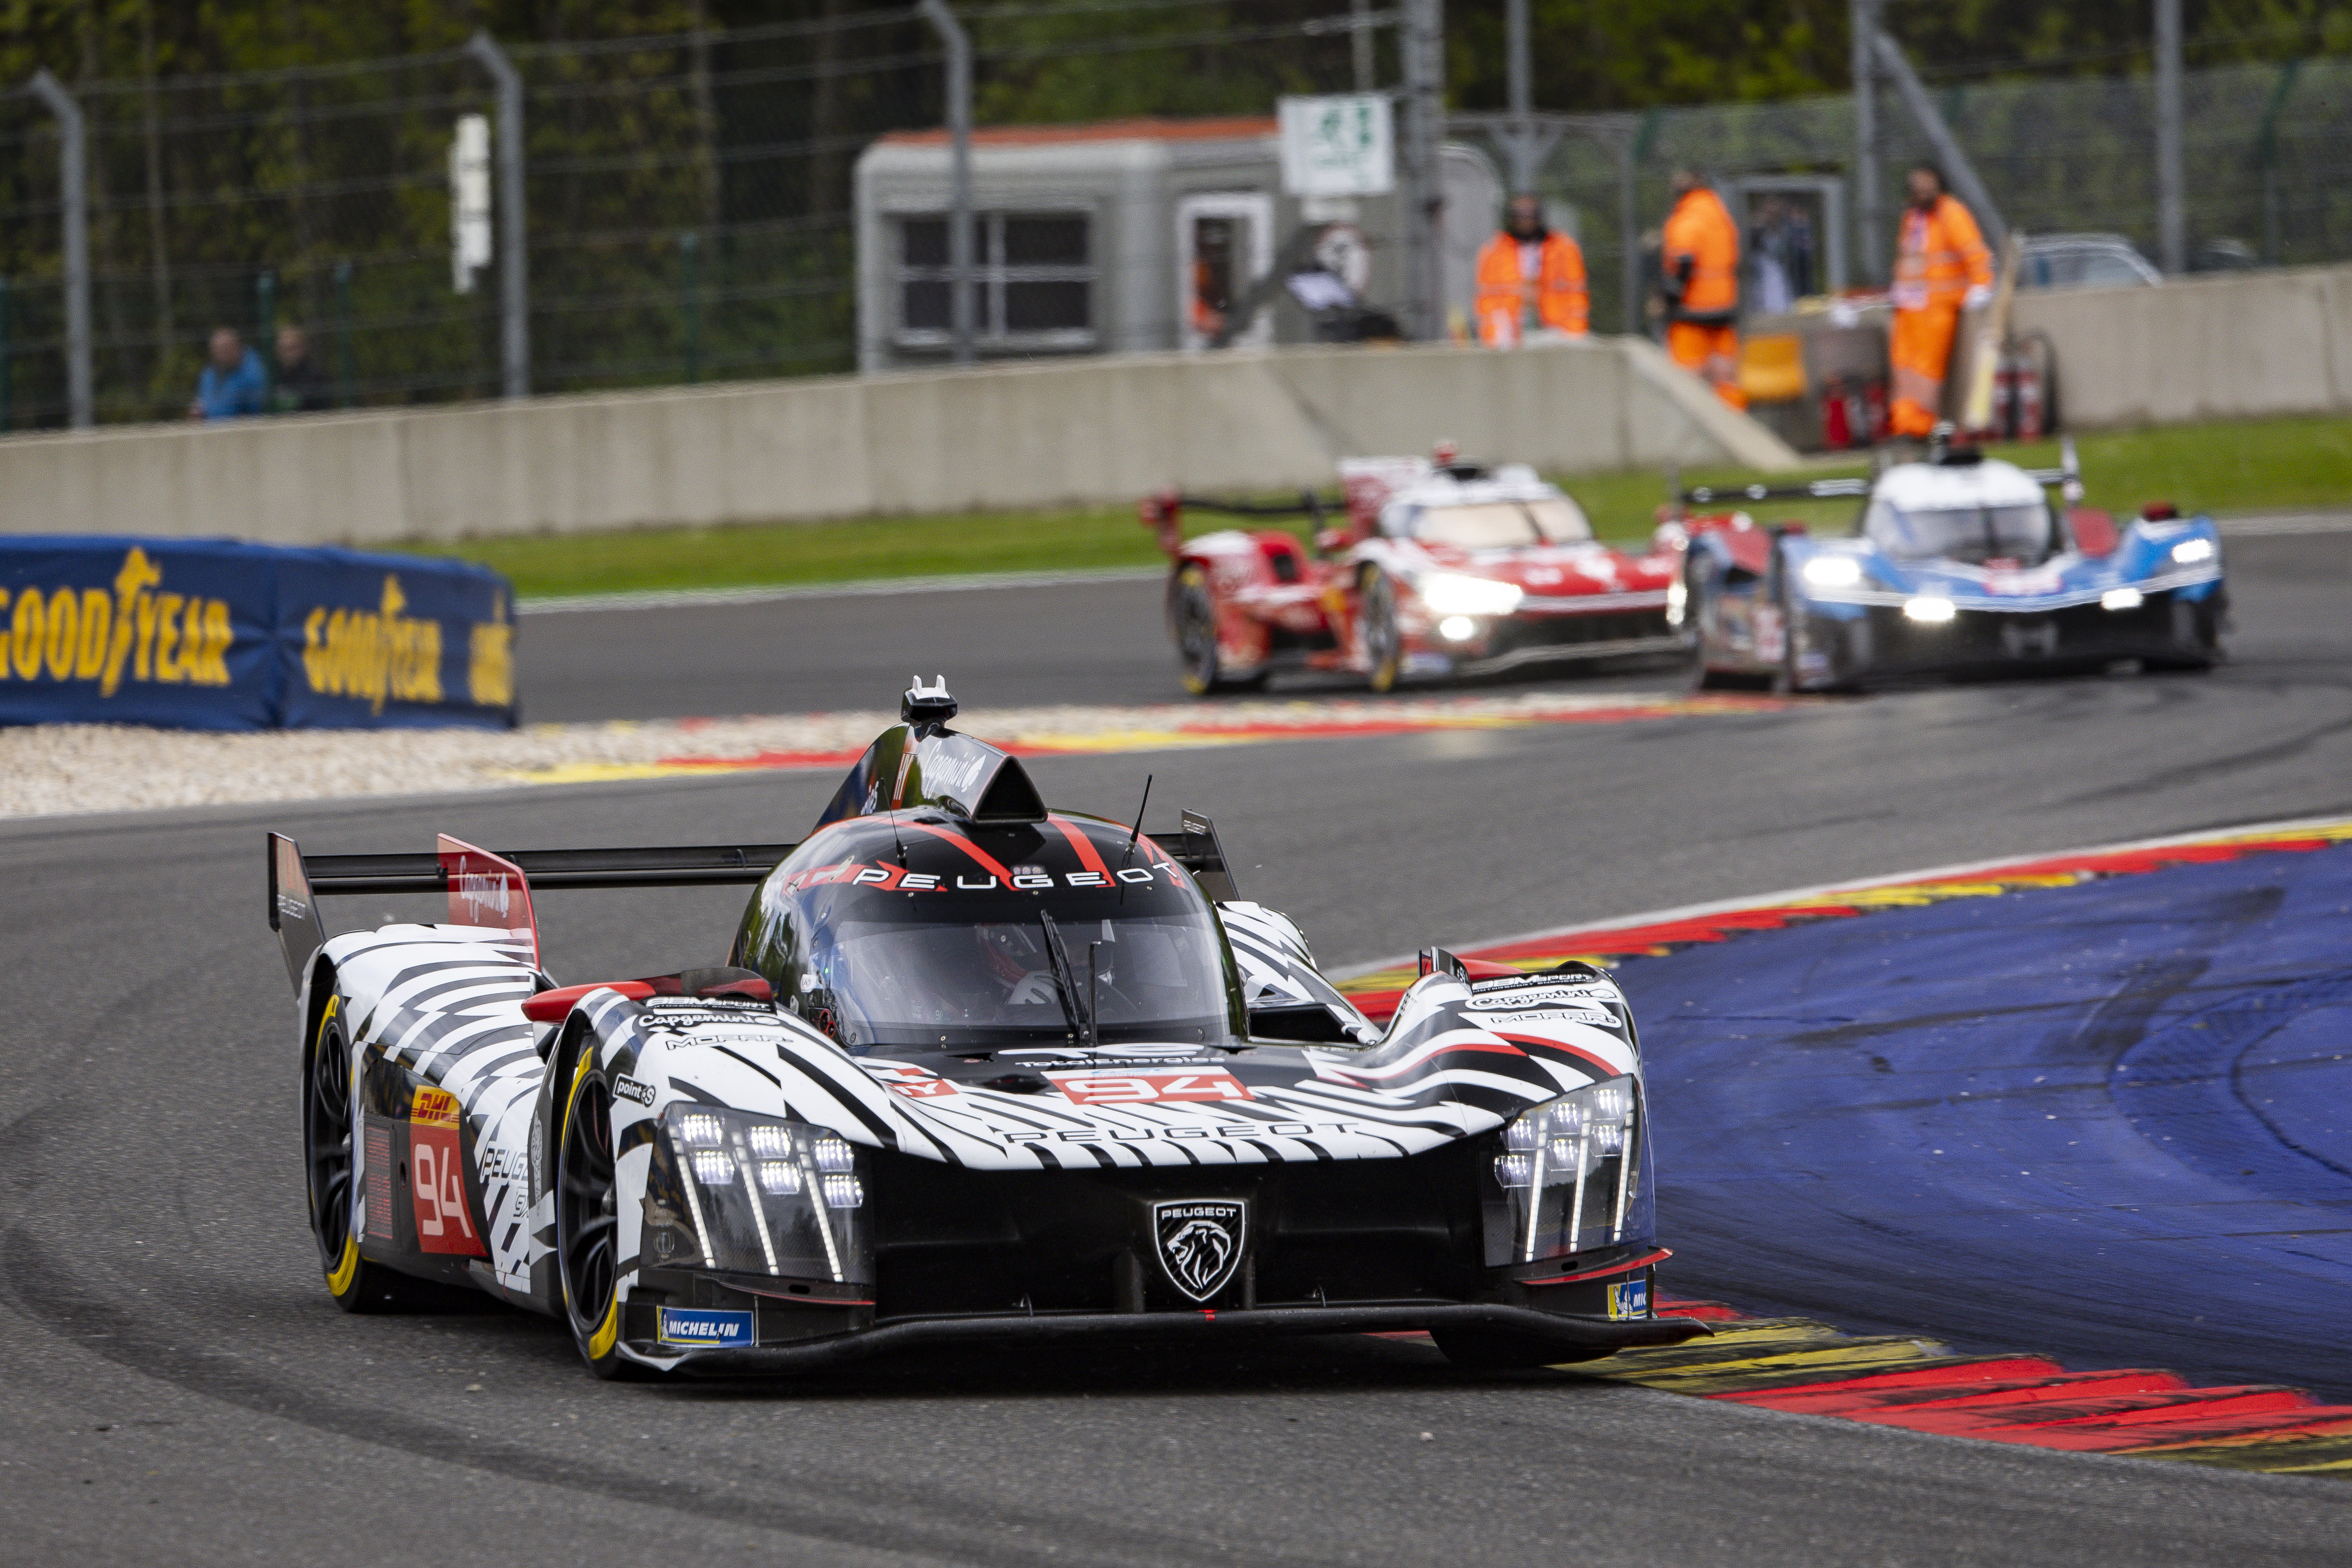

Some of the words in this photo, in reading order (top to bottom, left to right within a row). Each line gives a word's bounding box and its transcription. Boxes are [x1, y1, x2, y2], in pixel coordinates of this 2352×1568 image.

[852, 862, 1177, 889] PEUGEOT
[1476, 989, 1592, 1006] Capgemini
[638, 1013, 756, 1027] Capgemini
[1015, 1056, 1225, 1068] TotalEnergies
[616, 1081, 642, 1099] point
[1065, 1077, 1244, 1102] 94
[417, 1092, 451, 1122] DHL
[1004, 1123, 1359, 1144] PEUGEOT
[415, 1143, 472, 1238] 94
[1161, 1206, 1237, 1220] PEUGEOT
[668, 1320, 740, 1337] MICHELIN
